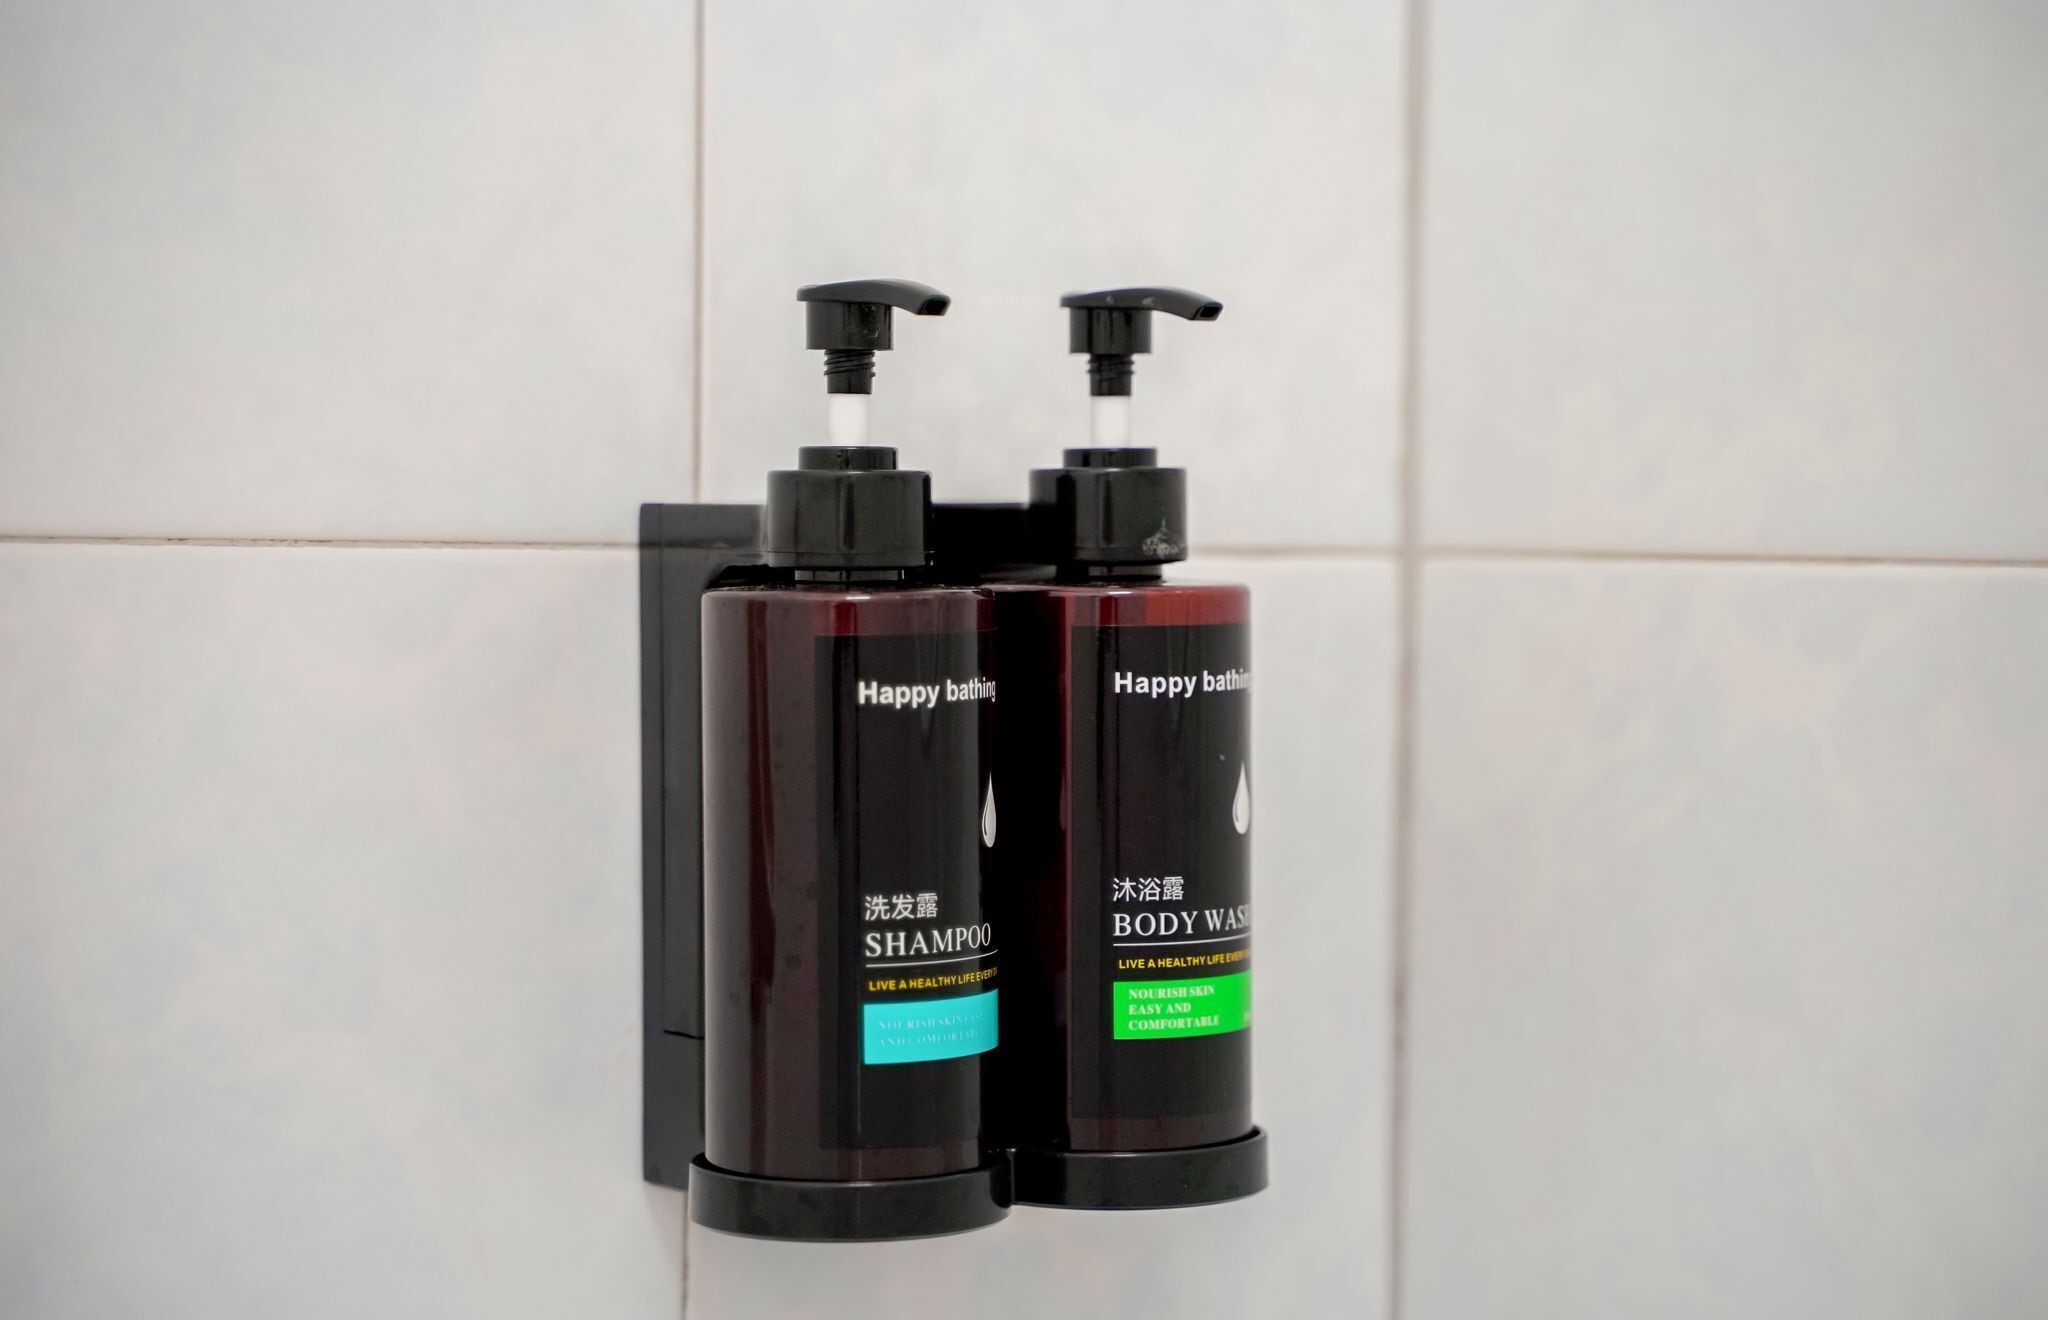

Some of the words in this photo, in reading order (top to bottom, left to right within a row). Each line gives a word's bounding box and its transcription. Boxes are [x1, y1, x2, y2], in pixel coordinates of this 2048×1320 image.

[858, 680, 940, 709] Happy
[946, 676, 996, 702] bathing
[1114, 671, 1197, 698] Happy
[1113, 876, 1184, 902] 沐浴露
[865, 893, 938, 920] 洗发露
[1113, 911, 1198, 937] BODY
[865, 923, 991, 957] SHAMPOO
[1119, 959, 1145, 969] LIVE
[1148, 959, 1156, 968] A
[1158, 956, 1206, 968] HEALTHY
[1207, 953, 1225, 965] LIFE
[868, 980, 896, 991] LIVE
[899, 980, 907, 989] A
[909, 975, 957, 989] HEALTHY
[958, 972, 976, 985] LIFE
[1128, 987, 1187, 999] NOURISH
[1189, 985, 1215, 997] SKIN
[1128, 1003, 1163, 1015] EASY
[1166, 1002, 1191, 1014] AND
[1128, 1015, 1220, 1031] COMFORTABLE
